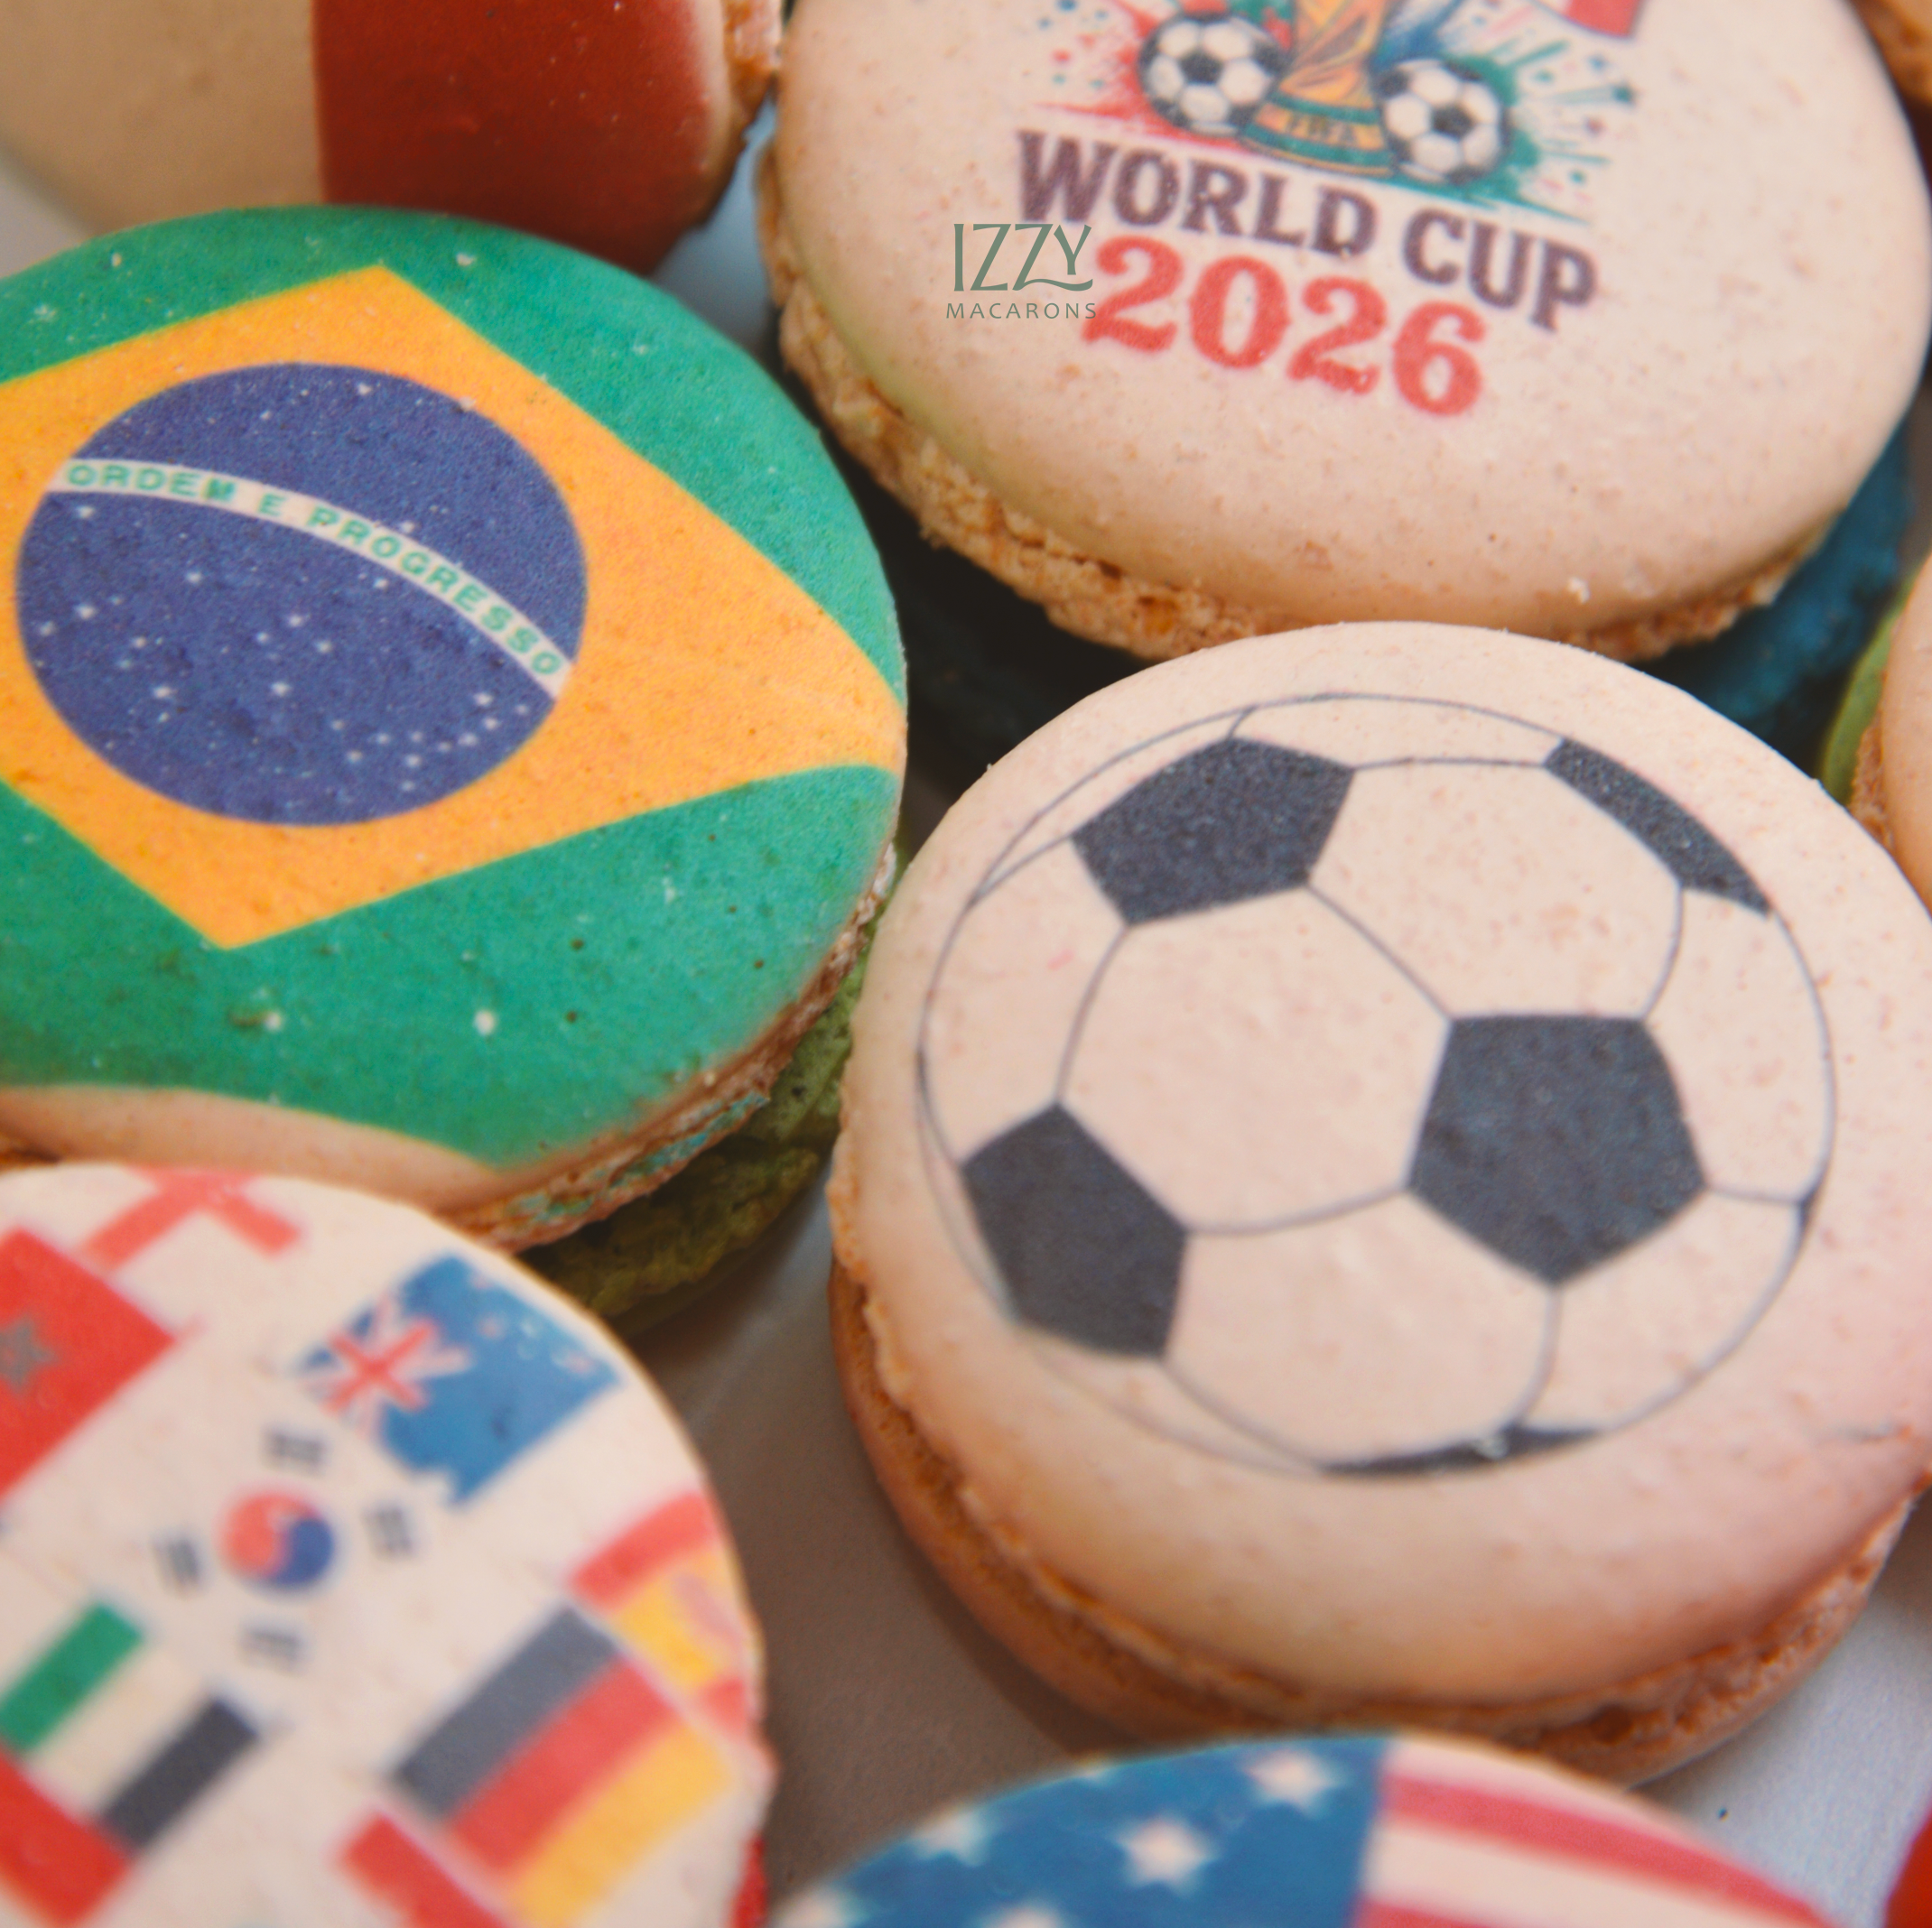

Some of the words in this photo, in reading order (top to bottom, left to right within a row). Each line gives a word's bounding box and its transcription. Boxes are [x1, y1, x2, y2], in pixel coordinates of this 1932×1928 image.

[1016, 130, 1378, 257] WORLD
[1402, 208, 1598, 333] CUP
[1083, 235, 1487, 416] 2026
[66, 464, 236, 502] ORDEM
[258, 494, 286, 516] E
[306, 506, 562, 676] PROGRESSO
